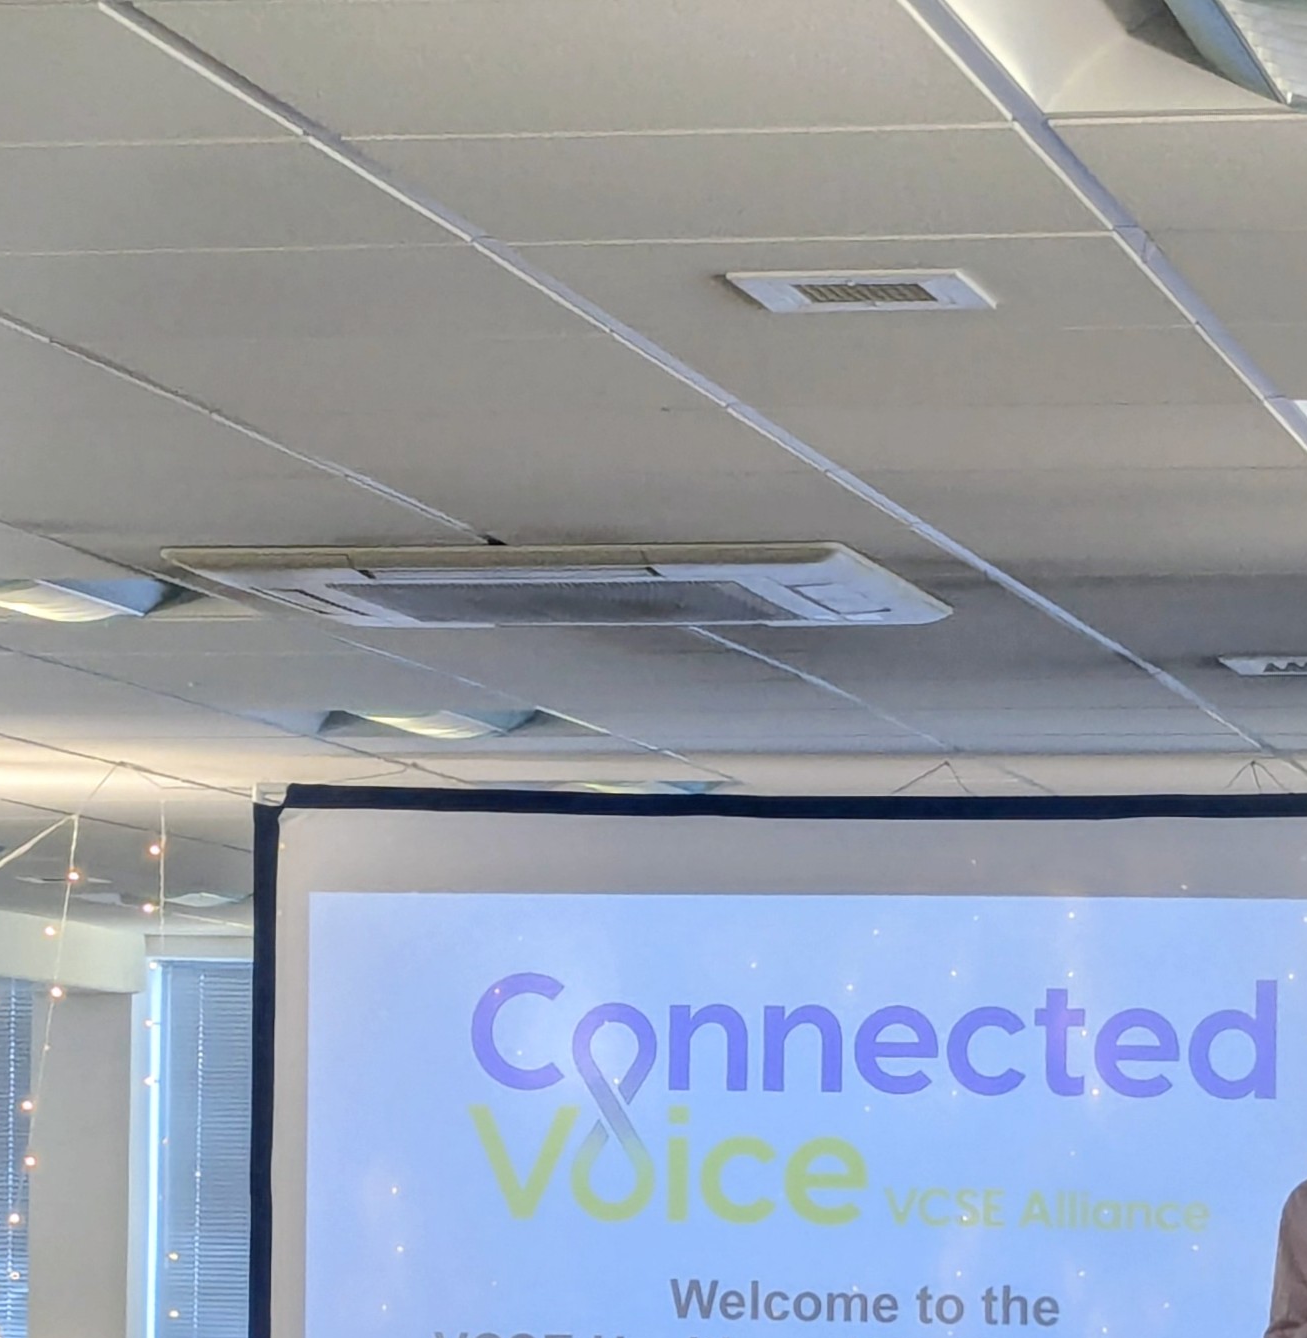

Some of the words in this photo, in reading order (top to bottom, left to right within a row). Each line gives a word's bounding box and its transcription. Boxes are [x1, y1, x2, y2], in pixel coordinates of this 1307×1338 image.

[471, 971, 1278, 1101] Connected
[468, 1104, 868, 1226] Voice
[885, 1187, 1005, 1229] VCSE
[1019, 1190, 1210, 1233] Alliance
[670, 1279, 899, 1323] Welcome
[915, 1286, 965, 1324] to
[981, 1285, 1060, 1326] the
